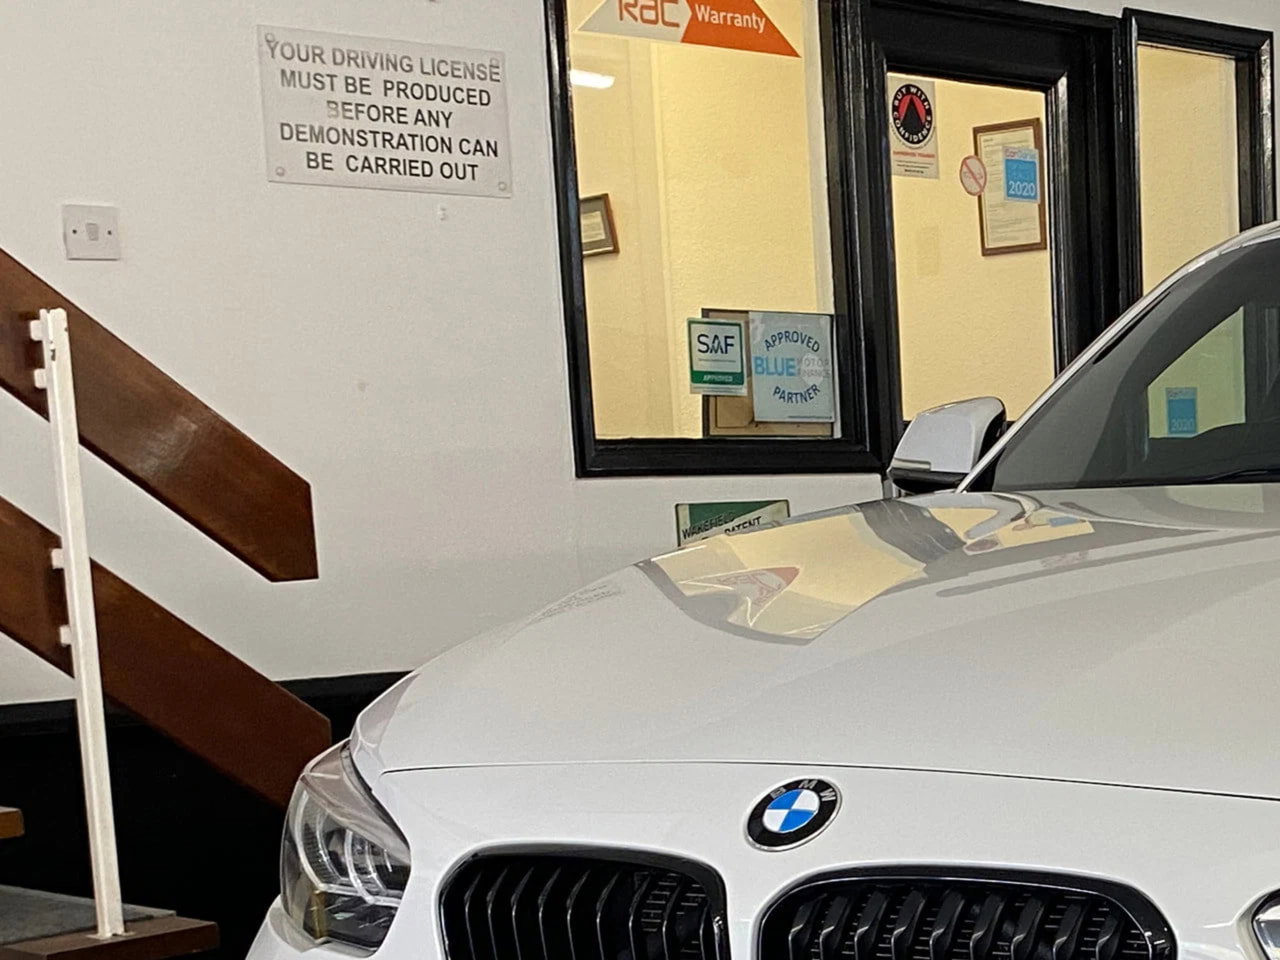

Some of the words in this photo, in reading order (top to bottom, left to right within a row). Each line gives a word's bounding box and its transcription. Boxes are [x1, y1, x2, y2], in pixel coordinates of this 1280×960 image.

[694, 4, 766, 33] Warranty
[265, 41, 326, 65] YOUR
[332, 48, 413, 73] DRIVING
[419, 57, 501, 83] LICENSE
[280, 69, 337, 92] MUST
[345, 76, 372, 96] BE
[383, 79, 491, 107] PRODUCED
[910, 86, 930, 109] WITH
[326, 100, 408, 125] BEFORE
[414, 109, 453, 129] ANY
[893, 111, 931, 142] CONFIDENCE
[280, 122, 453, 155] DEMONSTRATION
[458, 138, 498, 158] CAN
[306, 151, 334, 171] BE
[346, 155, 433, 178] CARRIED
[439, 162, 479, 181] OUT
[1008, 180, 1036, 196] 2020
[697, 333, 735, 354] SAF
[764, 330, 820, 353] APPROVED
[753, 356, 796, 377] BLUE
[773, 384, 821, 404] PARTNER
[769, 779, 837, 802] BMW
